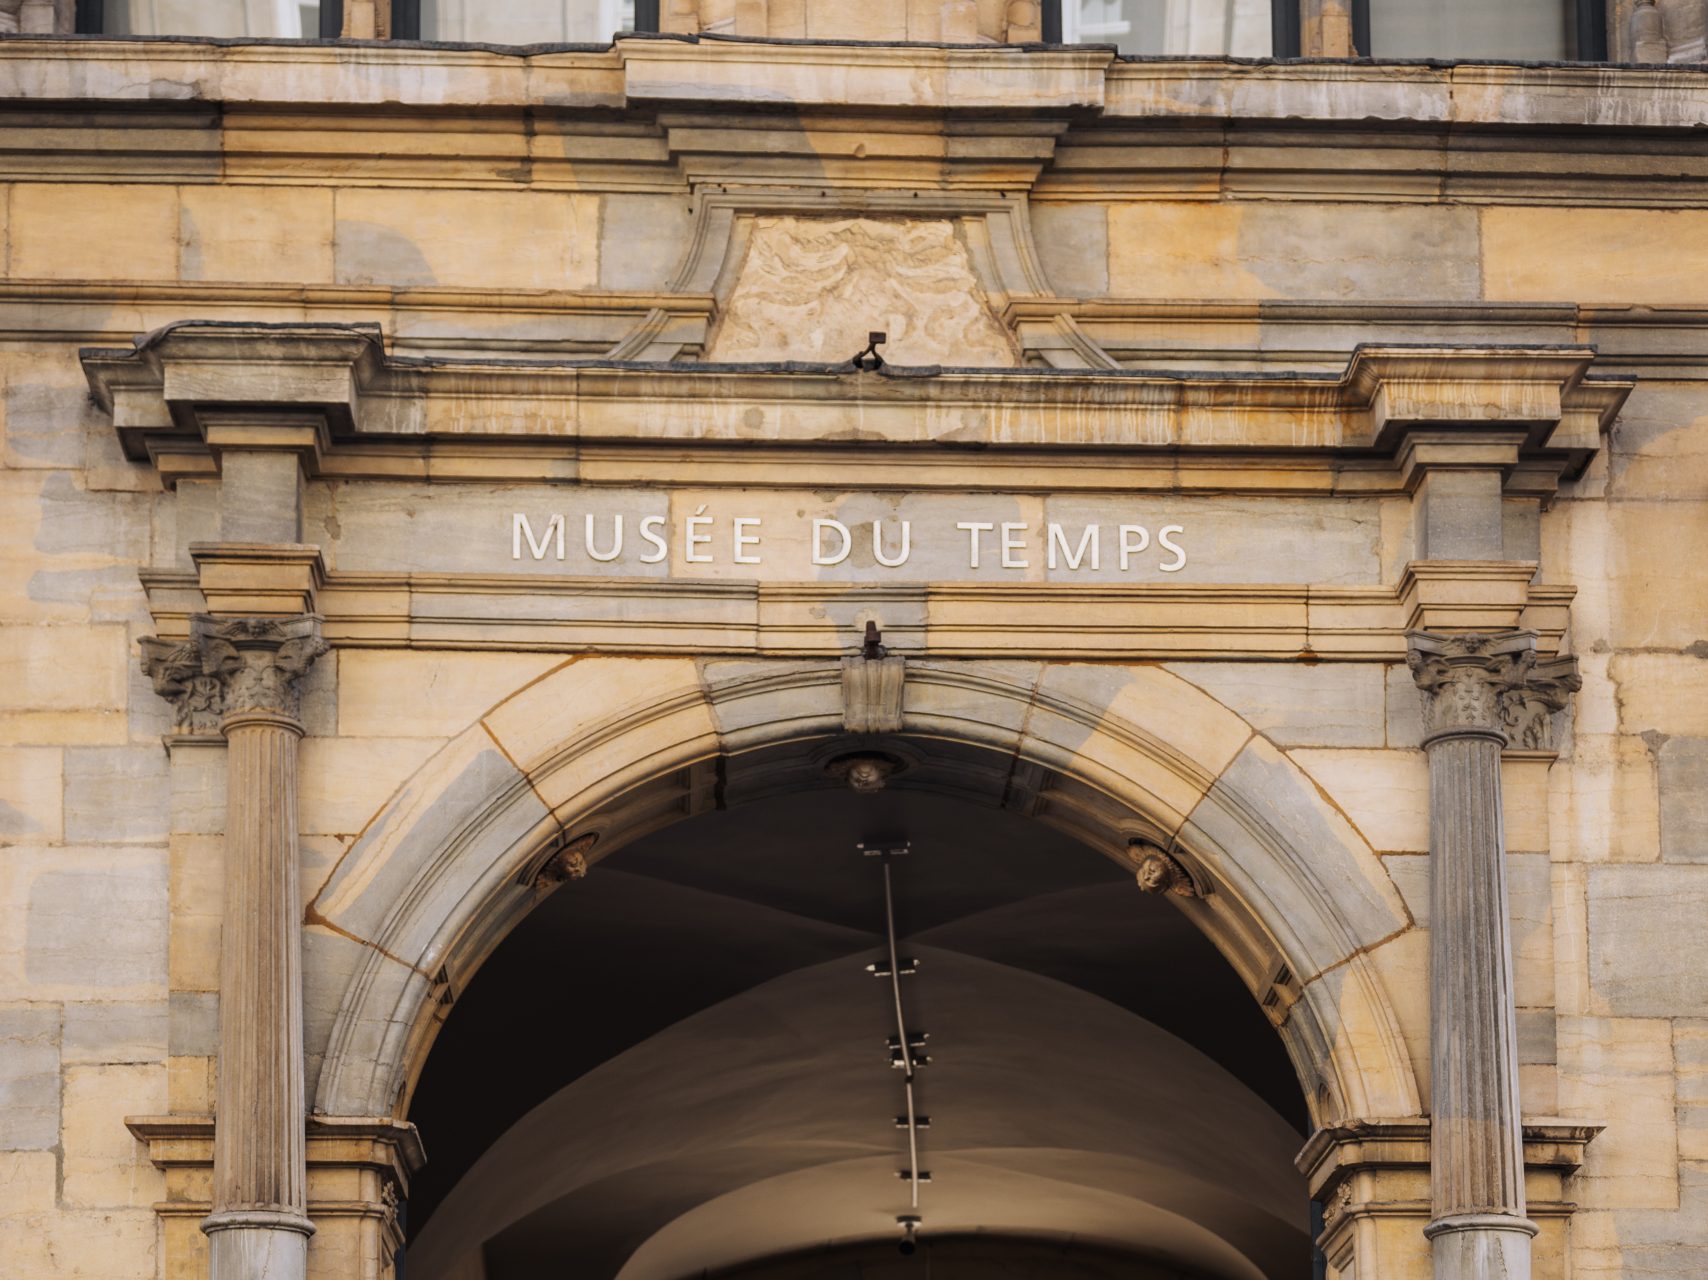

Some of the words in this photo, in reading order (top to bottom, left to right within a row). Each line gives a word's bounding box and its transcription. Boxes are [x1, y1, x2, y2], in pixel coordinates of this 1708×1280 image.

[512, 504, 762, 564] MUSÉE
[811, 518, 911, 567] DU
[957, 521, 1188, 572] TEMPS
